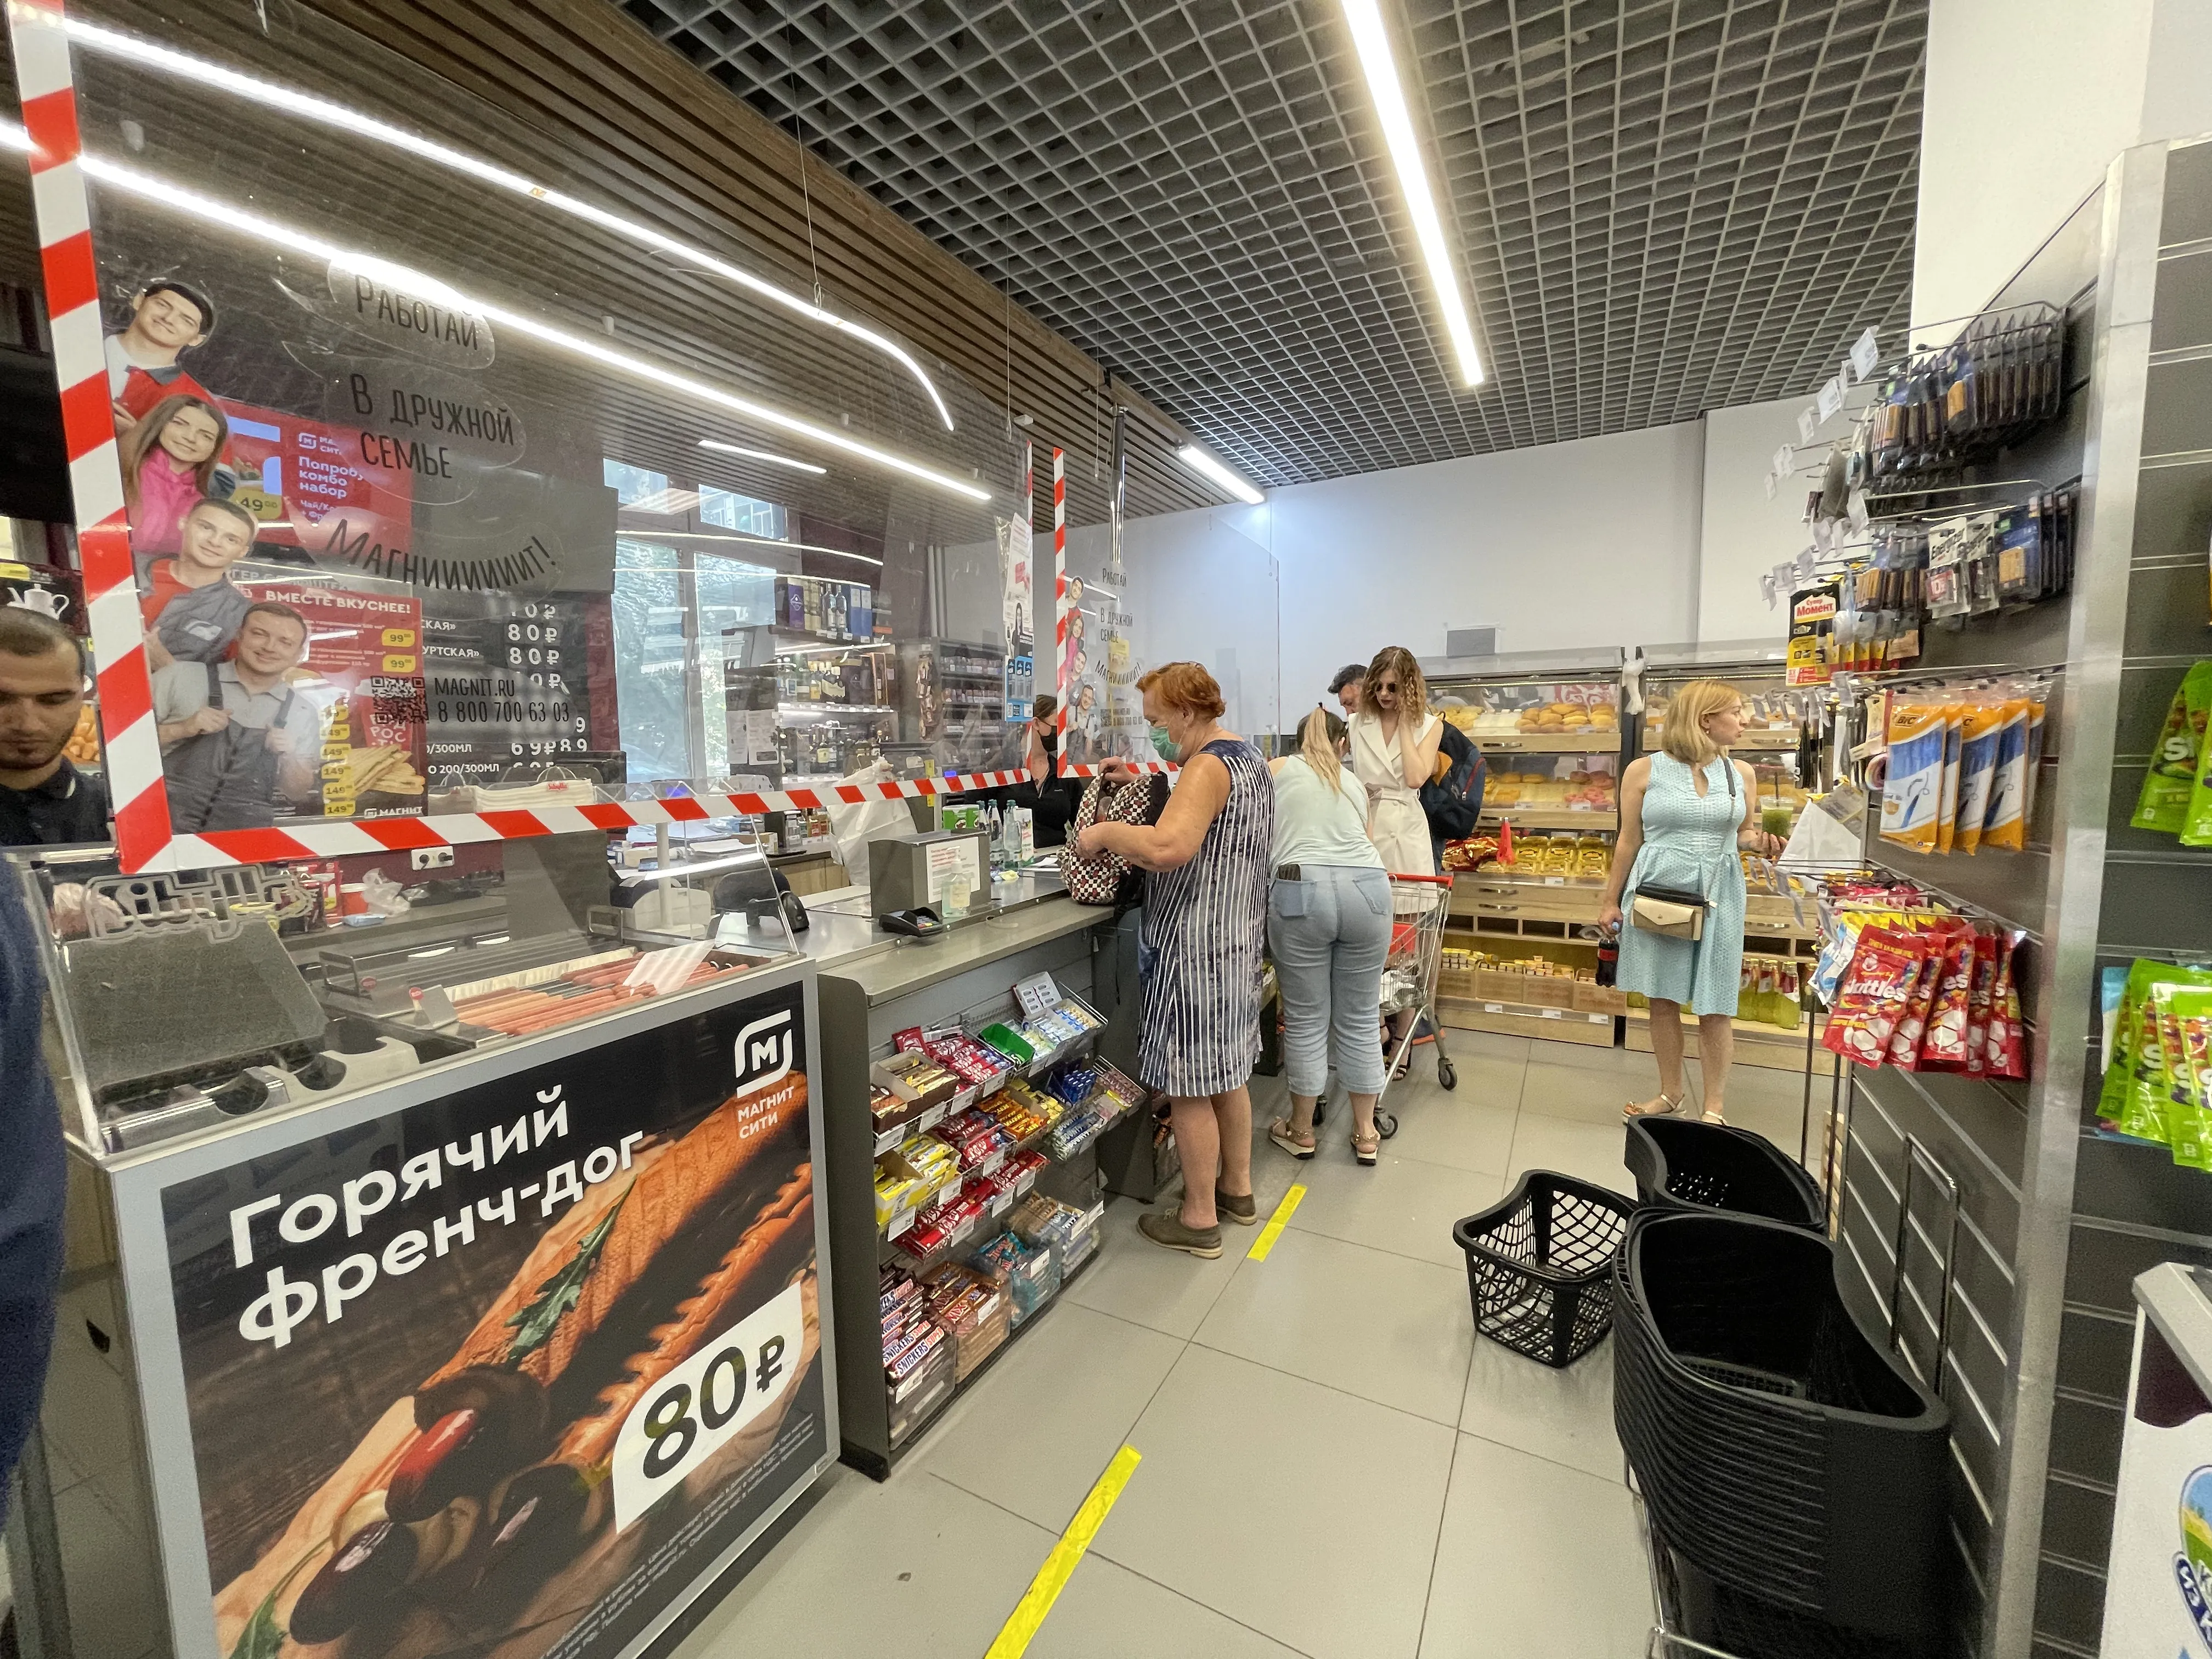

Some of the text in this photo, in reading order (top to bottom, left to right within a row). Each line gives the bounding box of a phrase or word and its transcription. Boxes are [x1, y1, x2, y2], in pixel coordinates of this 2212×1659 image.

[350, 374, 514, 446] В ДРУЖНОЙ
[360, 432, 452, 479] СЕМЬЕ
[299, 470, 348, 487] комбо
[299, 482, 347, 499] набор
[266, 590, 411, 614] ВМЕСТЕ ВКУСНЕЕ!
[1796, 602, 1833, 617] Момент
[1101, 607, 1105, 623] В
[422, 646, 479, 658] УРТСКАЯ»
[434, 677, 515, 697] MAGNIT.RU
[438, 701, 569, 723] 8 800 700 63 03
[439, 764, 500, 774] 200/300МЛ
[737, 1086, 795, 1122] МАГНИТ
[739, 1111, 778, 1139] СИТИ
[228, 1085, 568, 1268] Горячий
[883, 1333, 915, 1362] SNICKERS
[896, 1327, 944, 1374] SNICKERS SUPER
